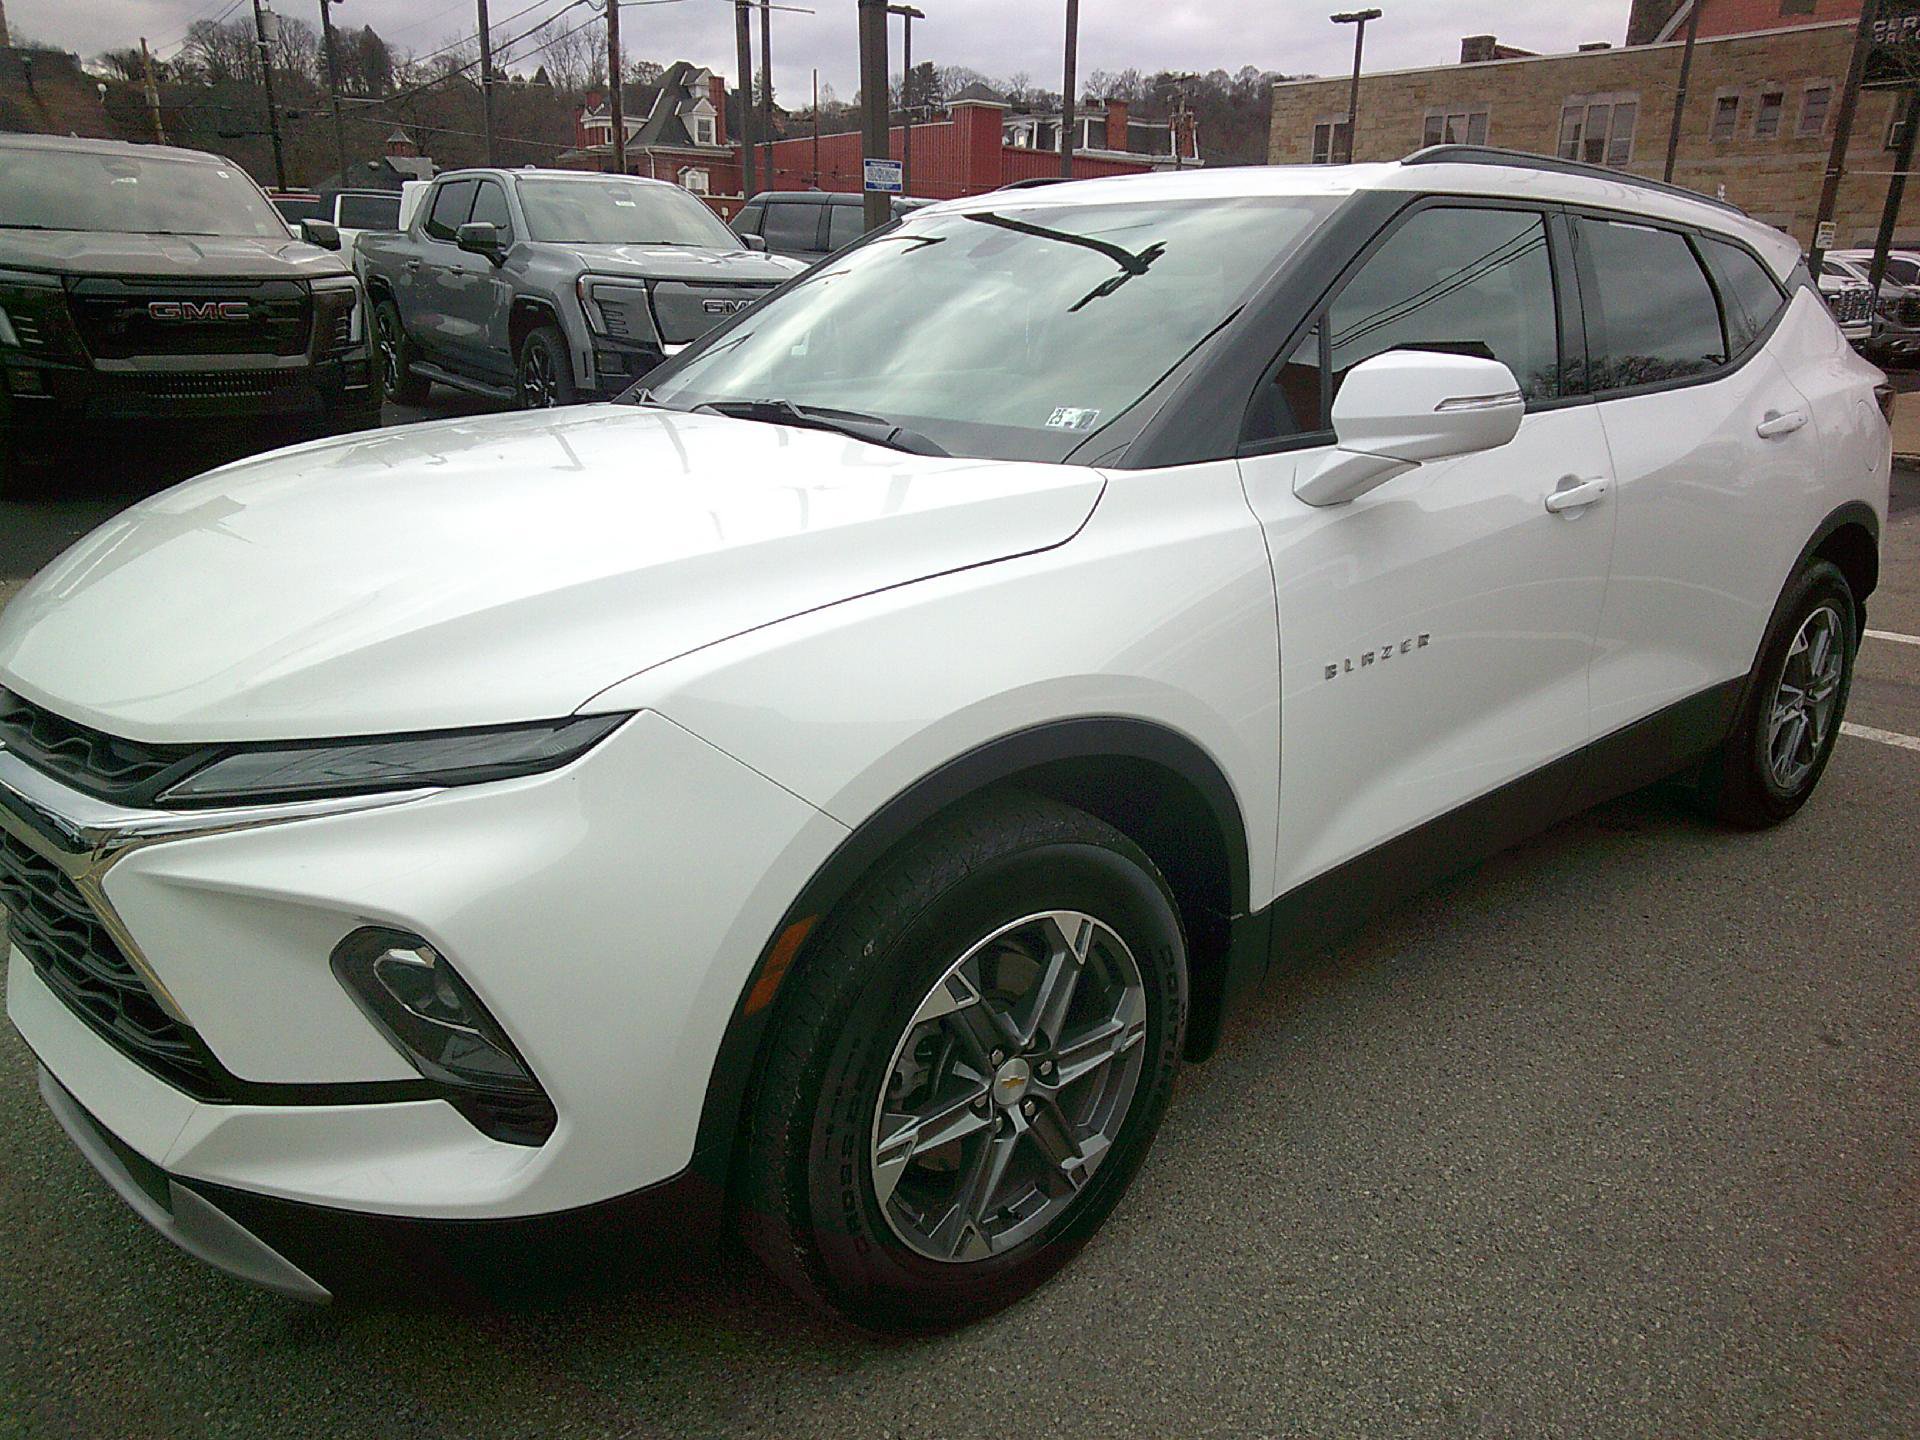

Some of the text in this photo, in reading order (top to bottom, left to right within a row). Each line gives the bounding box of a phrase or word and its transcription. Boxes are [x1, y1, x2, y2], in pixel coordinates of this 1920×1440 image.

[148, 301, 249, 320] GMC
[702, 299, 757, 315] GM
[1324, 633, 1430, 680] BLAZER
